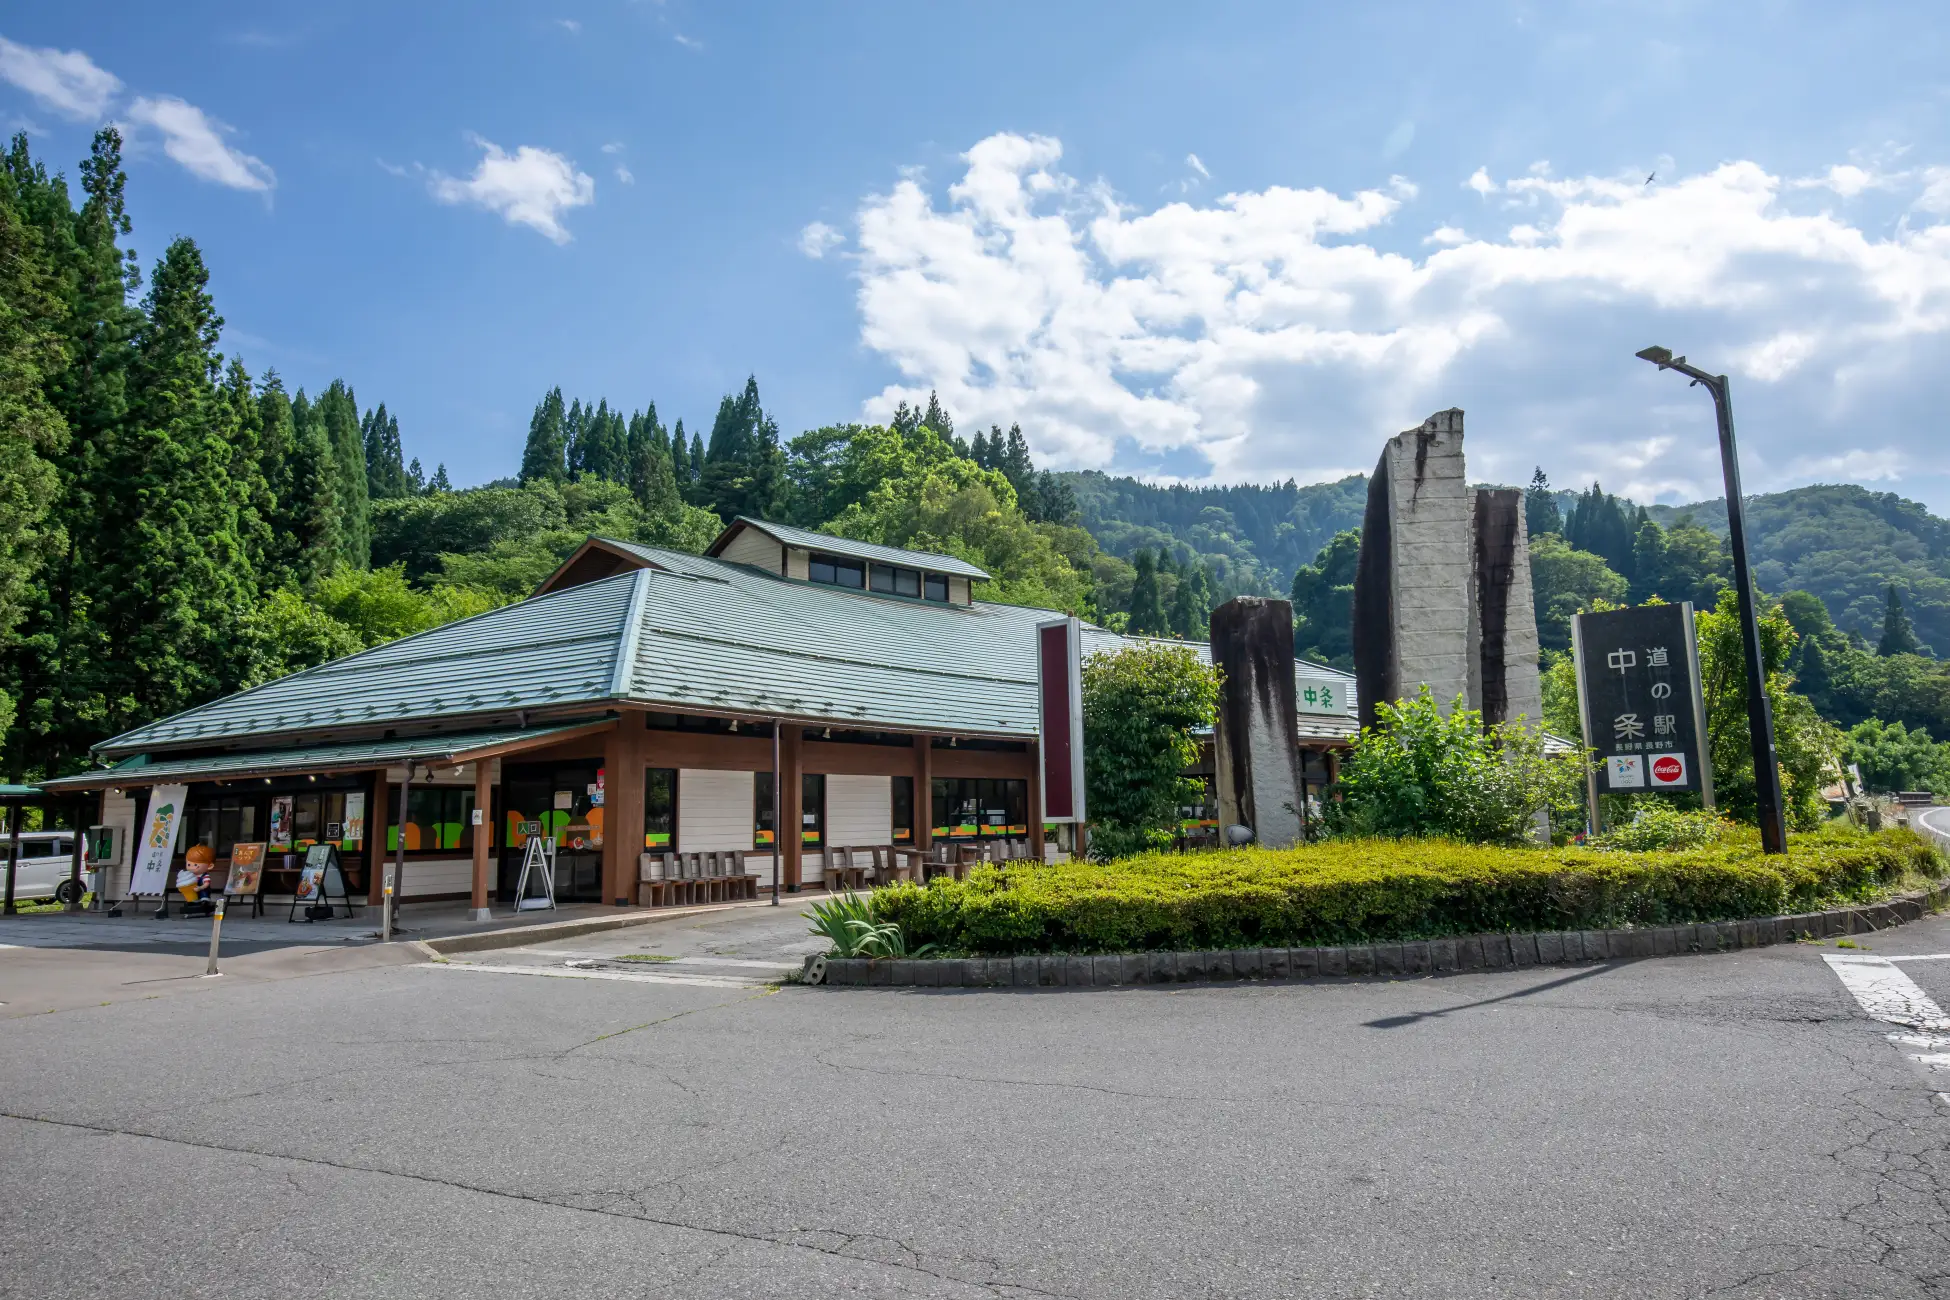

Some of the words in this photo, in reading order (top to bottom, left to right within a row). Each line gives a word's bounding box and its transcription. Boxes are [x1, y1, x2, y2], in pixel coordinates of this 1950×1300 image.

[1608, 648, 1645, 739] 中条
[1646, 647, 1676, 735] 道の駅
[1615, 742, 1643, 751] 長野県
[1645, 740, 1673, 750] 長野市
[519, 823, 537, 834] 入口
